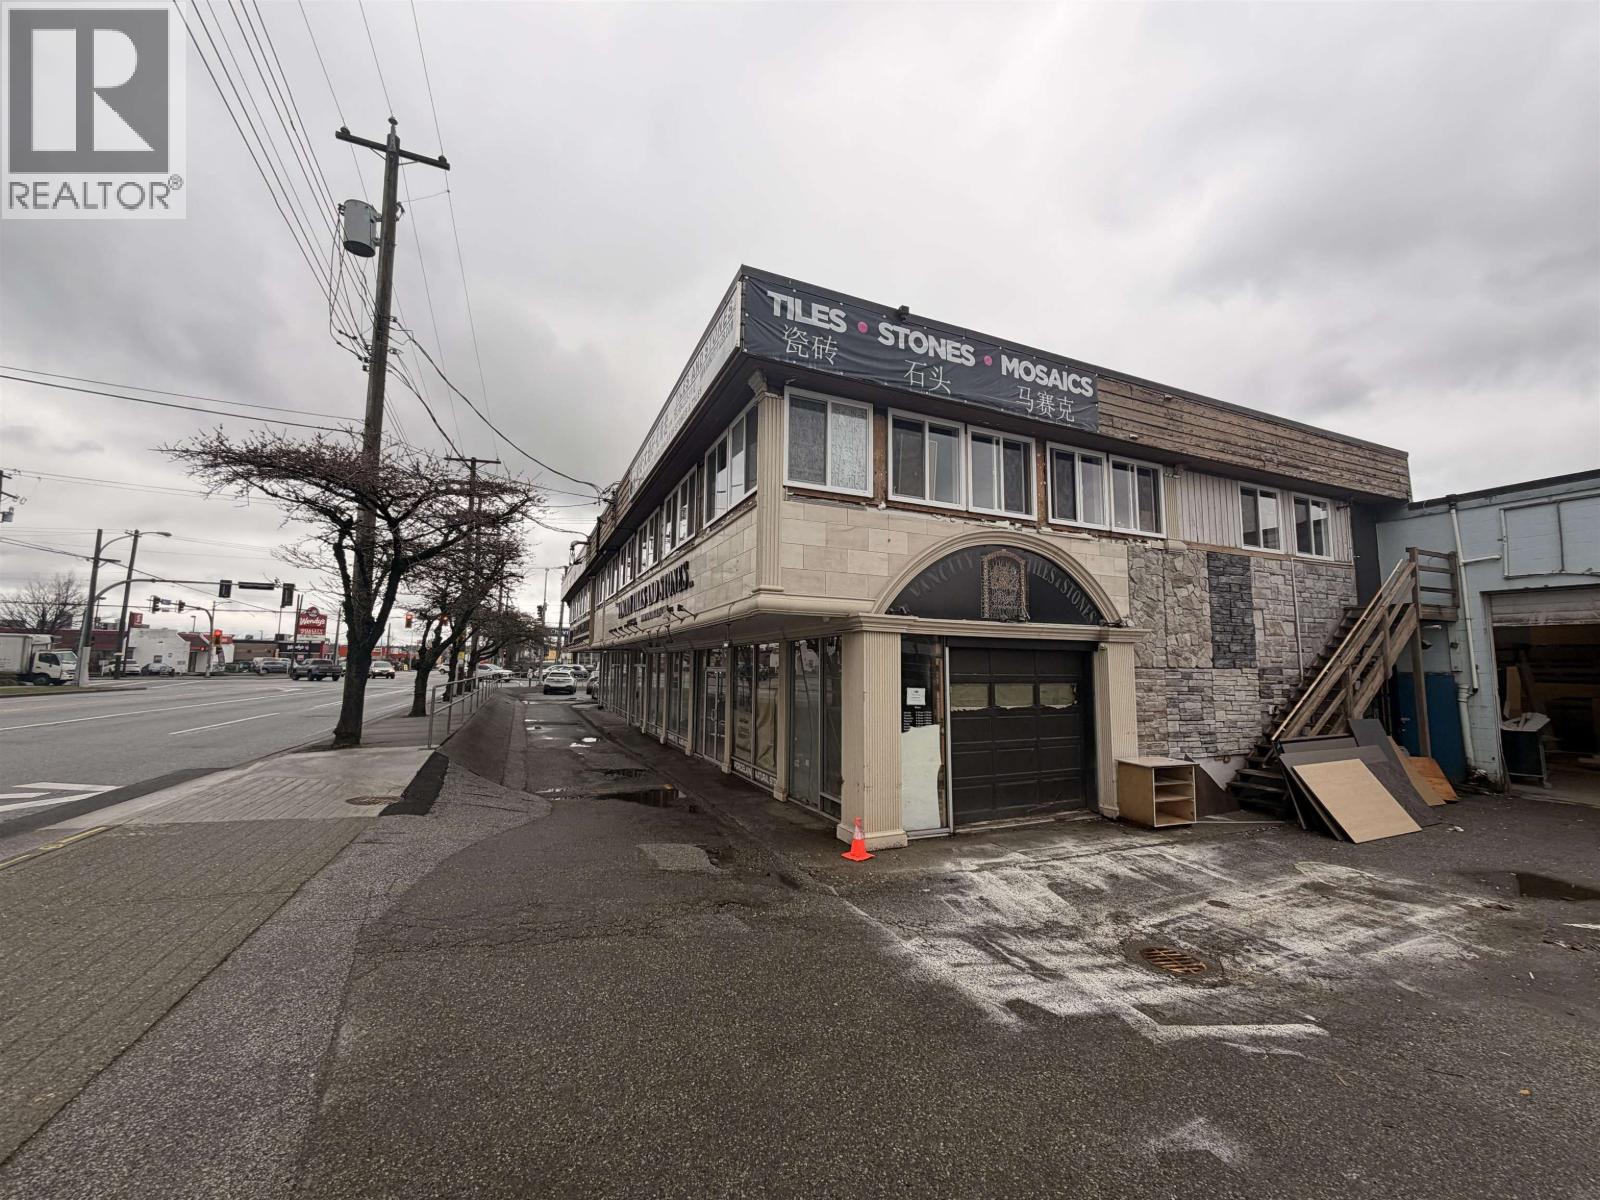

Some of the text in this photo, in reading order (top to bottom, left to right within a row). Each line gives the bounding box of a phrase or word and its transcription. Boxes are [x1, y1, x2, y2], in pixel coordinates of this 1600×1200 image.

[767, 290, 1094, 398] TILES STONES MOSAICS
[782, 324, 1075, 423] 瓷砖 石头 马赛克
[300, 617, 325, 626] Wendy's
[909, 552, 975, 598] VANCITY
[1060, 580, 1097, 625] STONES
